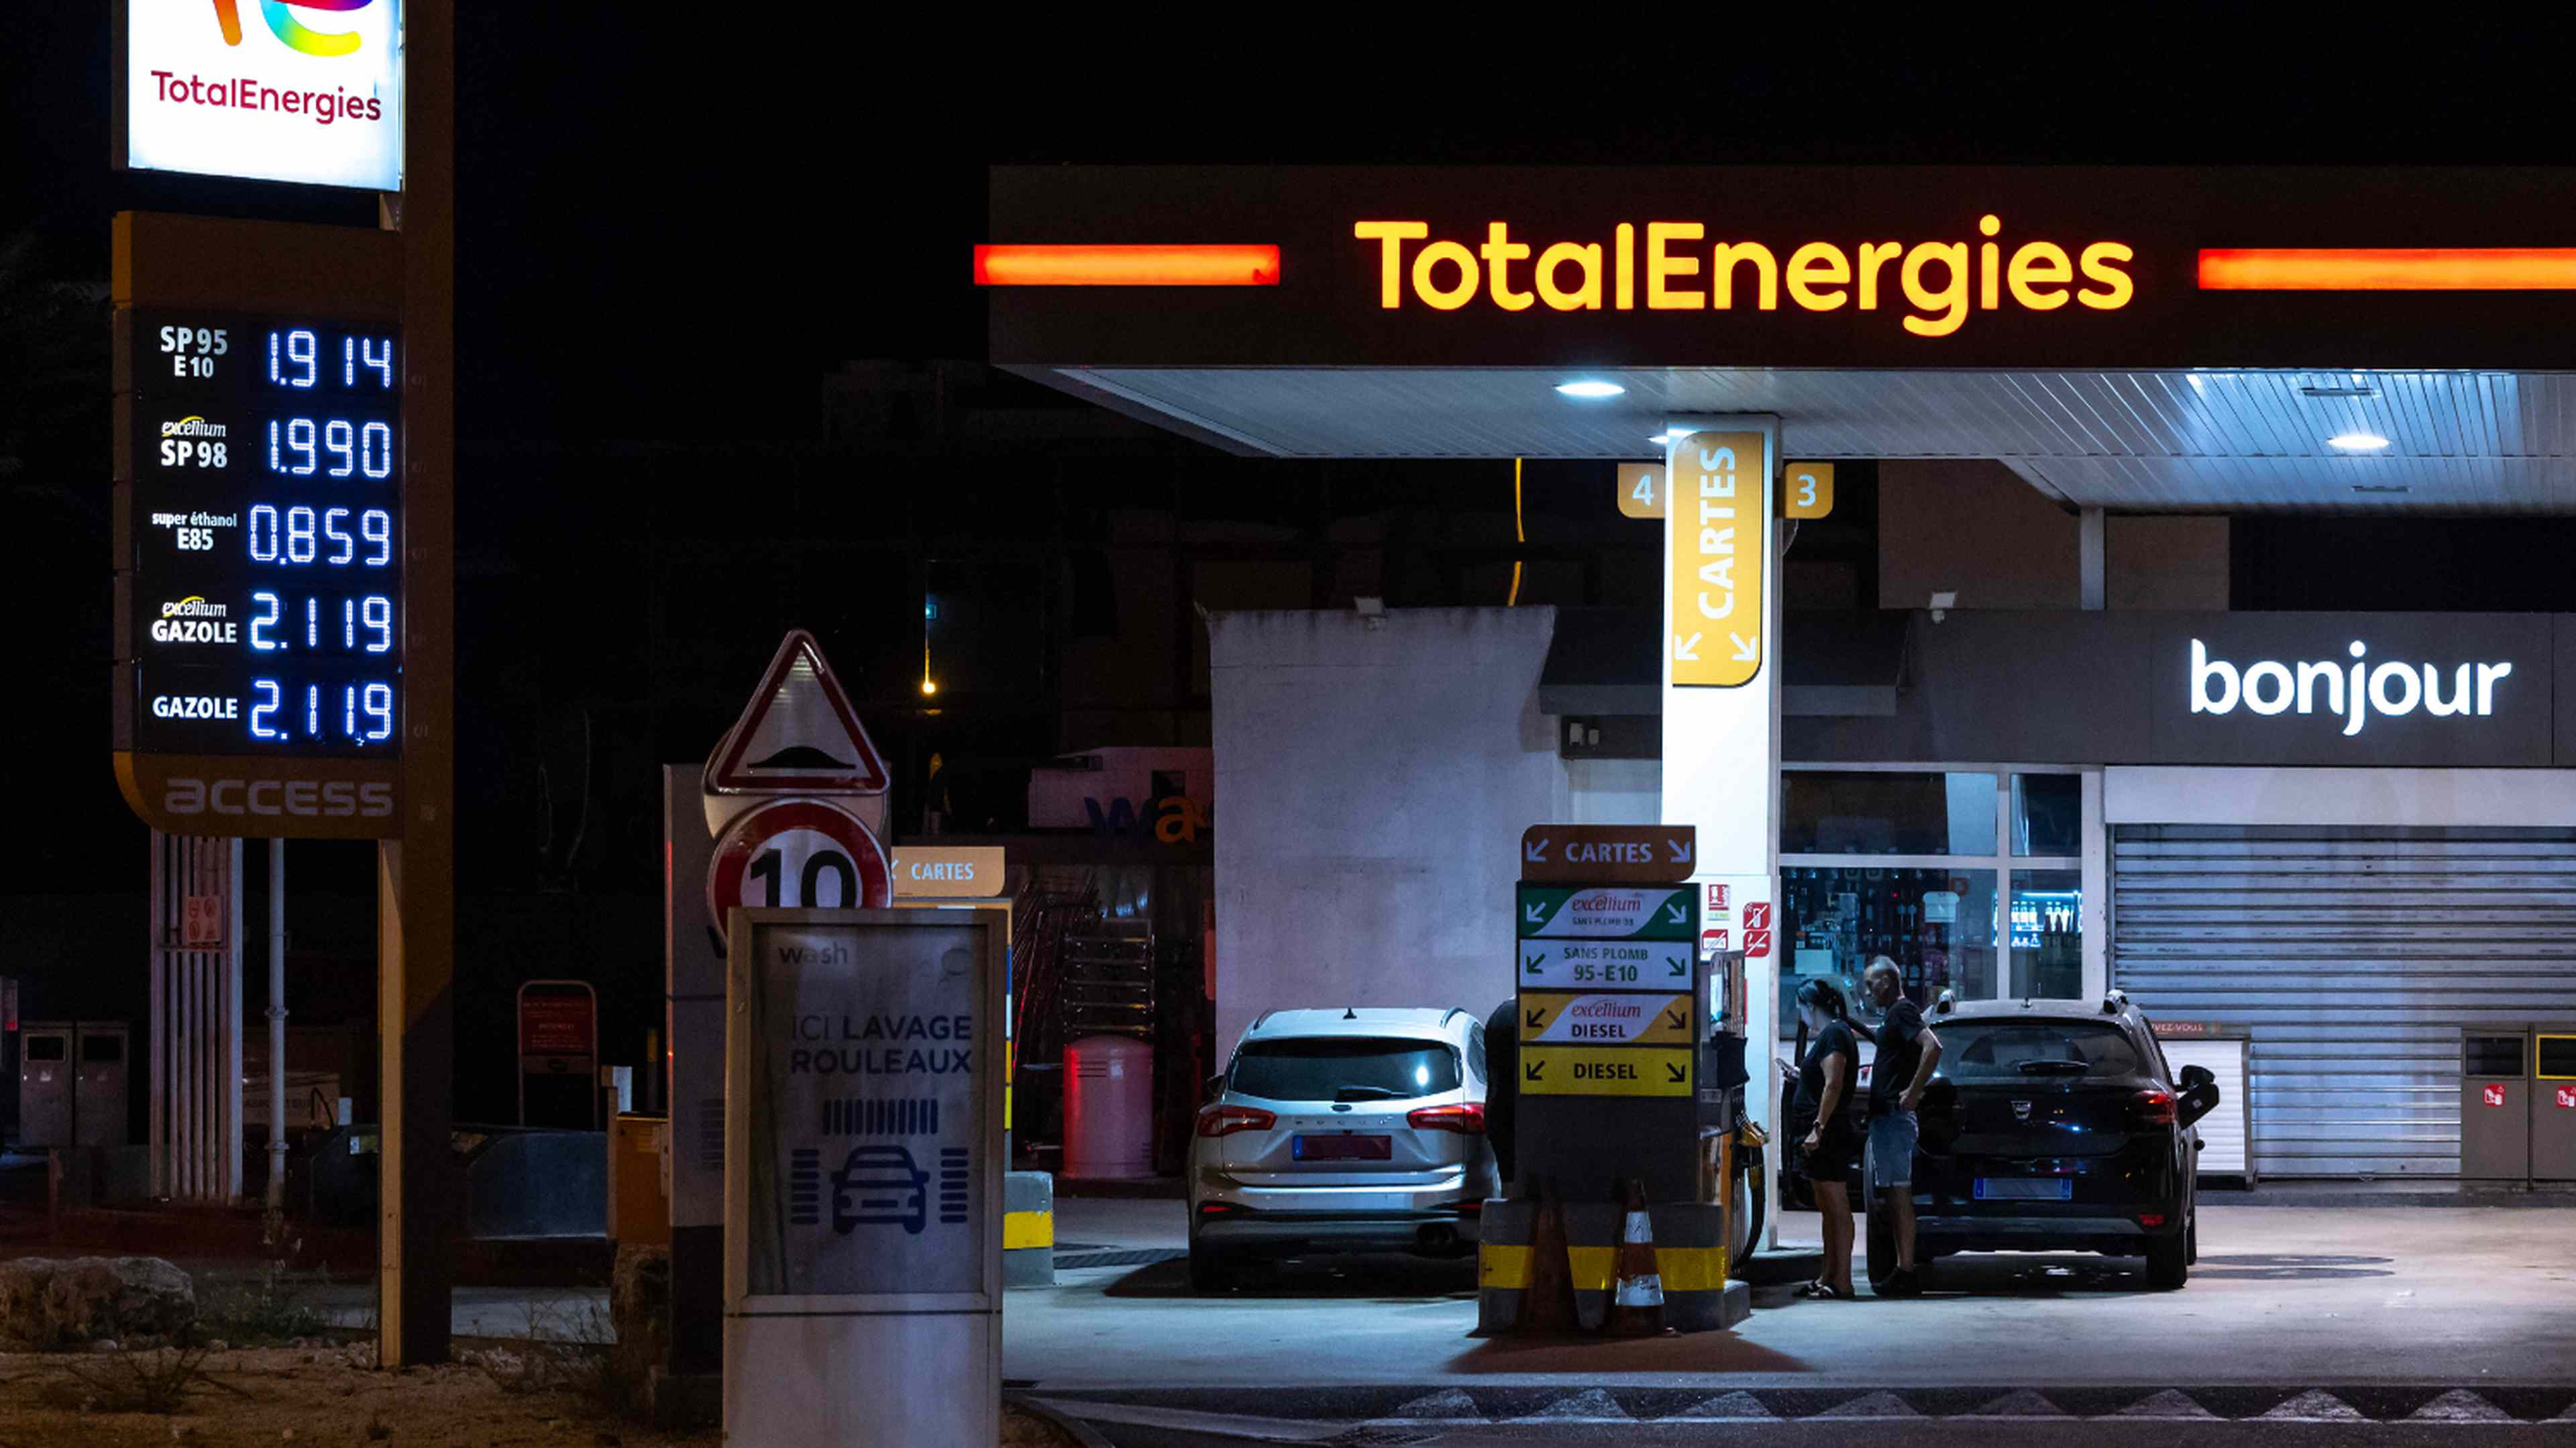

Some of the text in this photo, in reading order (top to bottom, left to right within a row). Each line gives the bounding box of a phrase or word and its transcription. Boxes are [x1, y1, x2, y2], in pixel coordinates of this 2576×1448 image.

[151, 70, 382, 125] TotalEnergies
[1354, 213, 2135, 337] TotalEnergies
[160, 325, 228, 355] SP 95
[162, 417, 227, 437] excellium
[160, 439, 228, 468] SP 98
[270, 419, 391, 478] 1.990
[1632, 474, 1654, 505] 4
[1797, 474, 1817, 507] 3
[152, 511, 237, 529] super éthanol
[1698, 446, 1735, 619] CARTES
[177, 528, 214, 550] E85
[250, 505, 390, 565] 0.859
[162, 596, 227, 618] excellium
[151, 619, 237, 643] GAZOLE
[250, 592, 391, 652] 2.119
[2190, 638, 2512, 736] bonjour
[152, 696, 238, 719] GAZOLE
[251, 680, 392, 739] 2.119
[1564, 841, 1653, 864] CARTES
[750, 848, 857, 907] 10
[910, 862, 975, 881] CARTES
[1572, 894, 1642, 913] excellium
[778, 941, 849, 965] wash
[1563, 947, 1648, 960] SANS PLOMB
[1573, 964, 1638, 982] 95-E10
[1571, 1000, 1642, 1018] excellium
[791, 1015, 973, 1041] ICI LAVAGE
[1571, 1024, 1627, 1038] DIESEL
[791, 1049, 973, 1075] ROULEAUX
[1573, 1063, 1638, 1080] DIESEL
